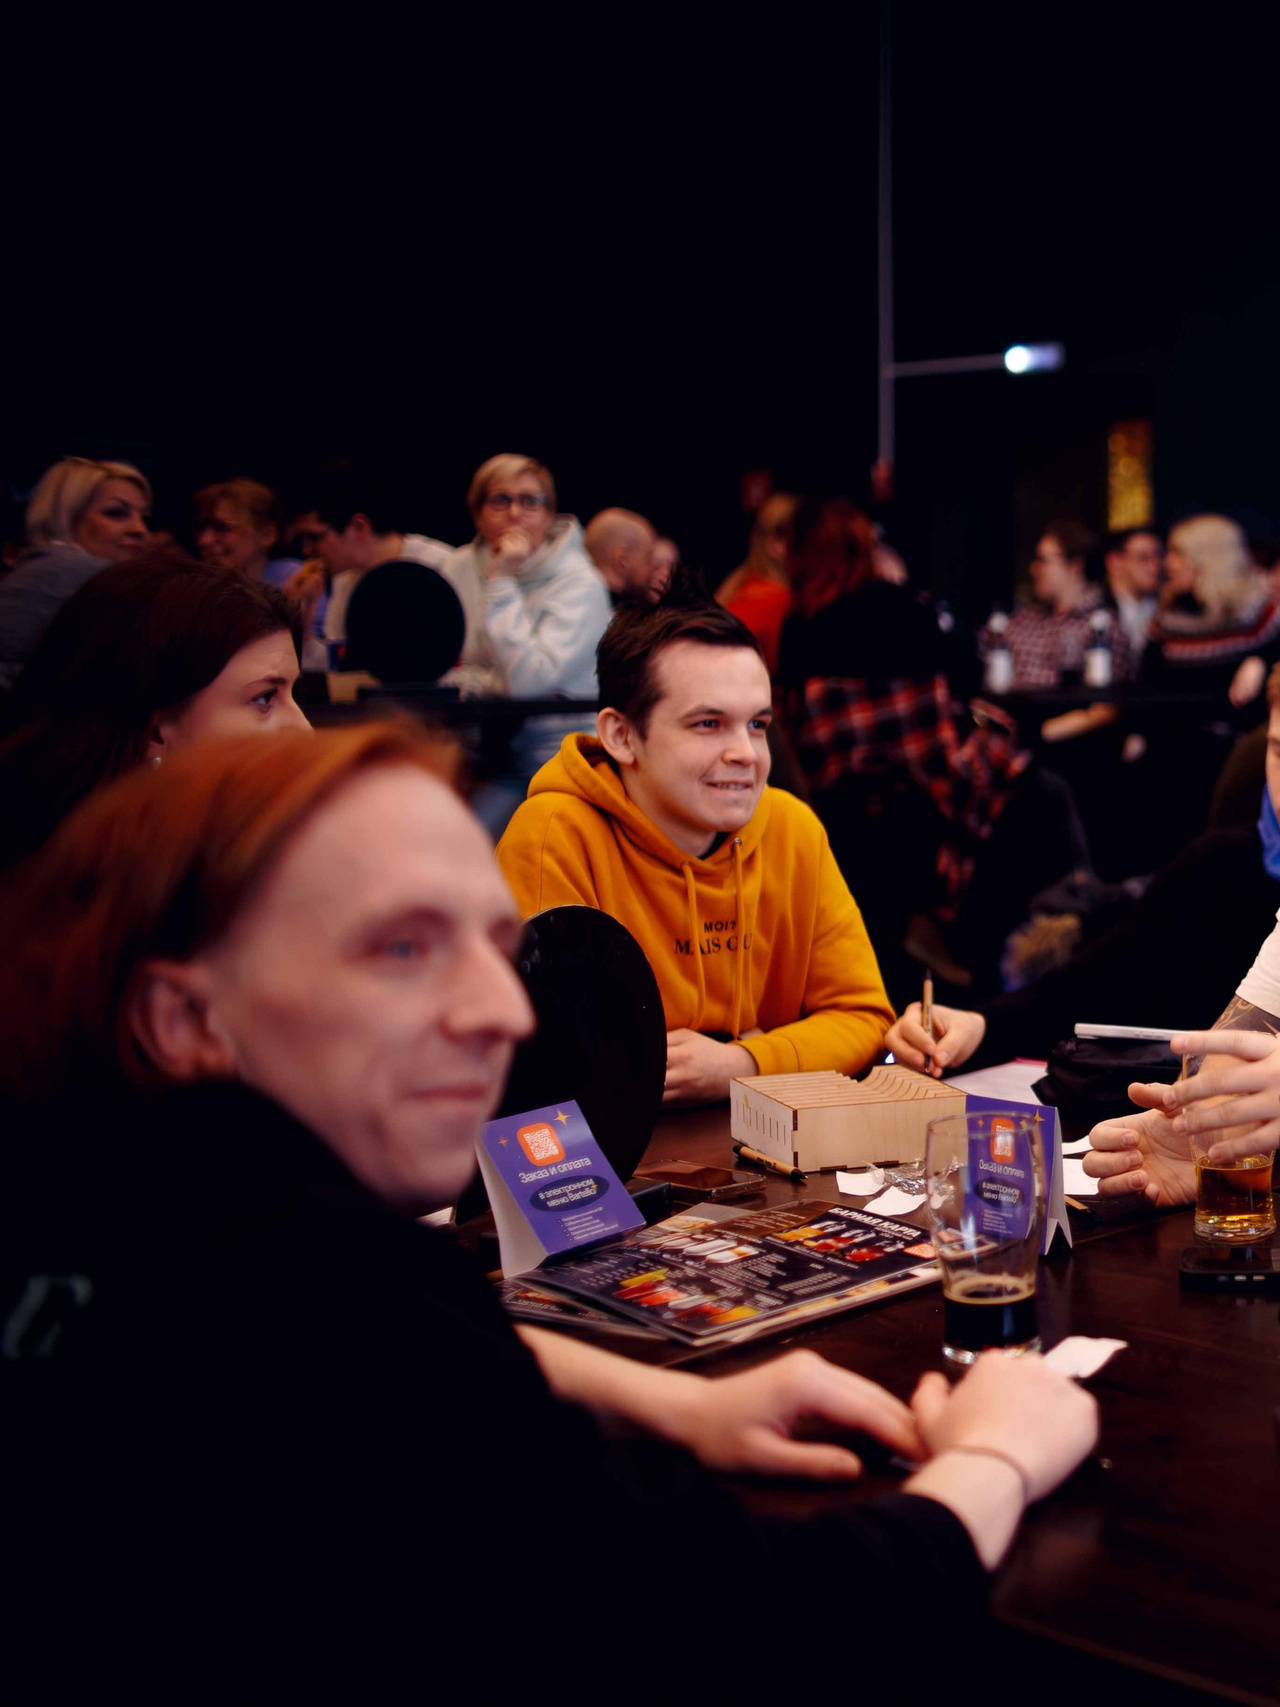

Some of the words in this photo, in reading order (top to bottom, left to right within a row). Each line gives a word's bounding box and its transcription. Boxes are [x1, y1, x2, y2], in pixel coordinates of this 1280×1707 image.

[703, 920, 738, 933] MOI?
[518, 1168, 550, 1184] Заказ
[557, 1157, 592, 1174] оплата
[827, 1207, 883, 1226] БАРНАЯ
[879, 1221, 922, 1238] КАРТА
